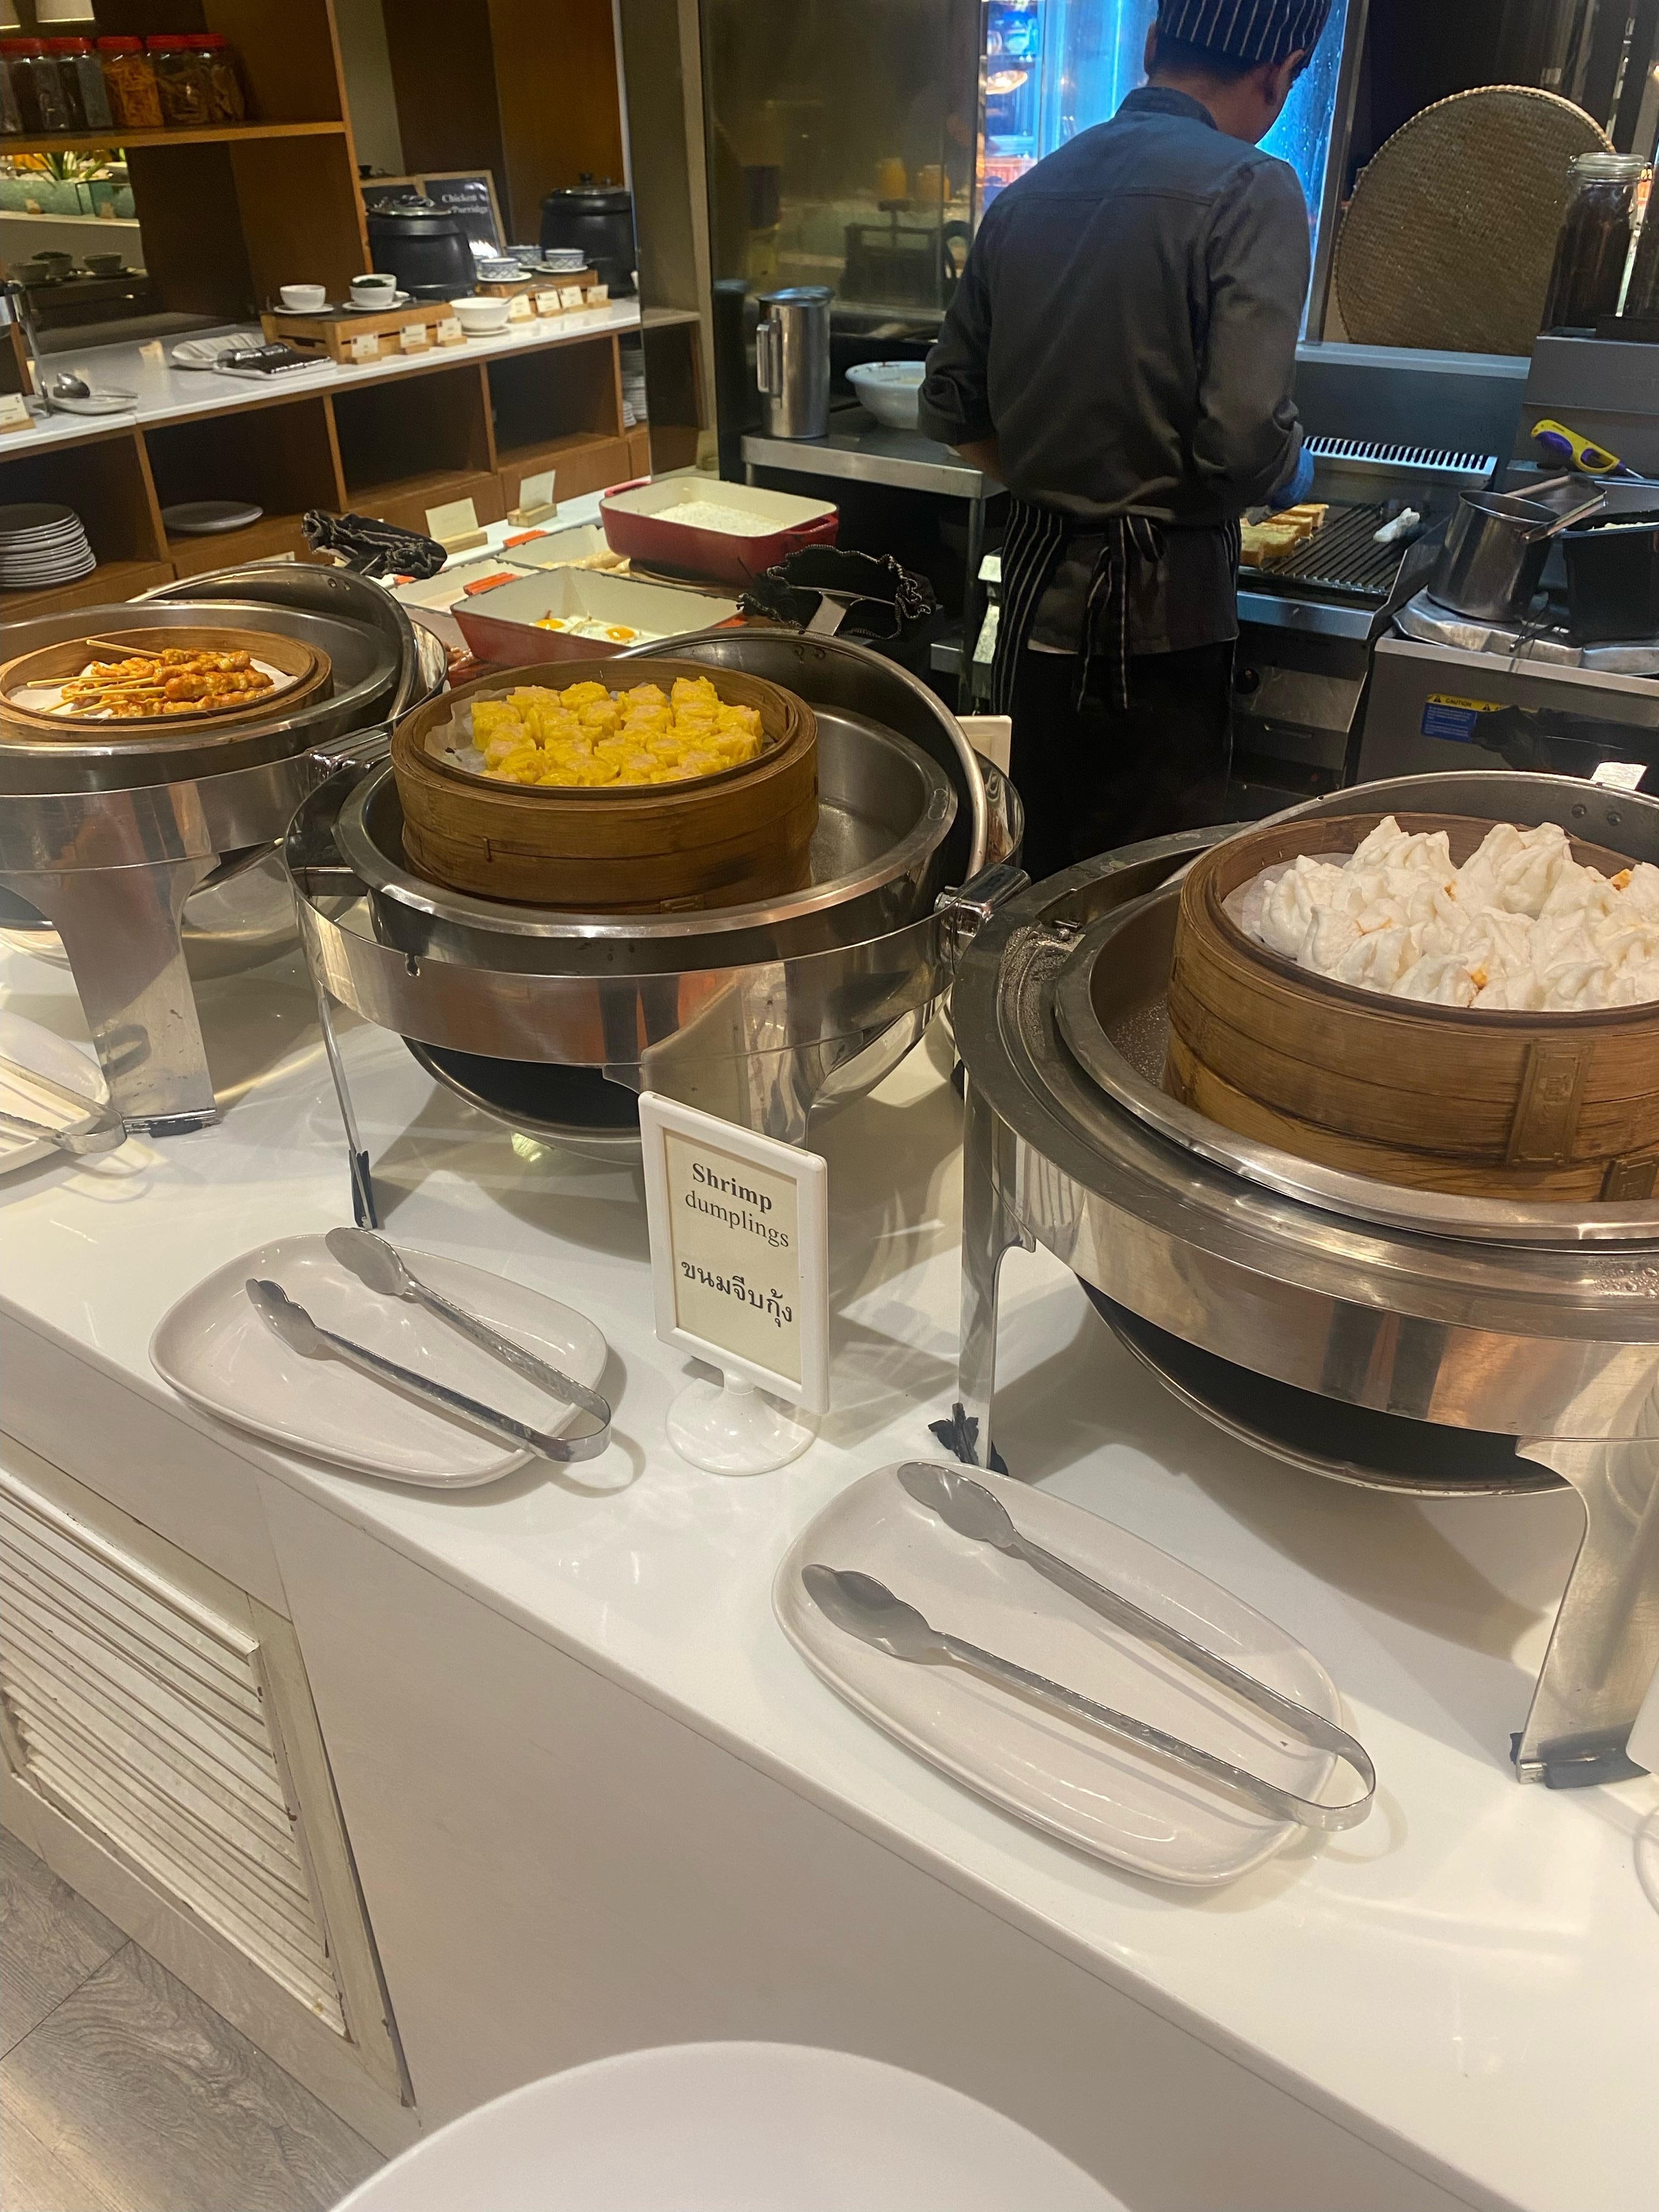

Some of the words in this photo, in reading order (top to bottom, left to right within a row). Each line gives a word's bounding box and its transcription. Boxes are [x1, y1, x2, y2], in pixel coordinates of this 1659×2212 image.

[692, 1163, 772, 1213] Shrimp
[685, 1190, 789, 1248] dumplings
[681, 1261, 792, 1328] ขนมจีบกุ้ง
